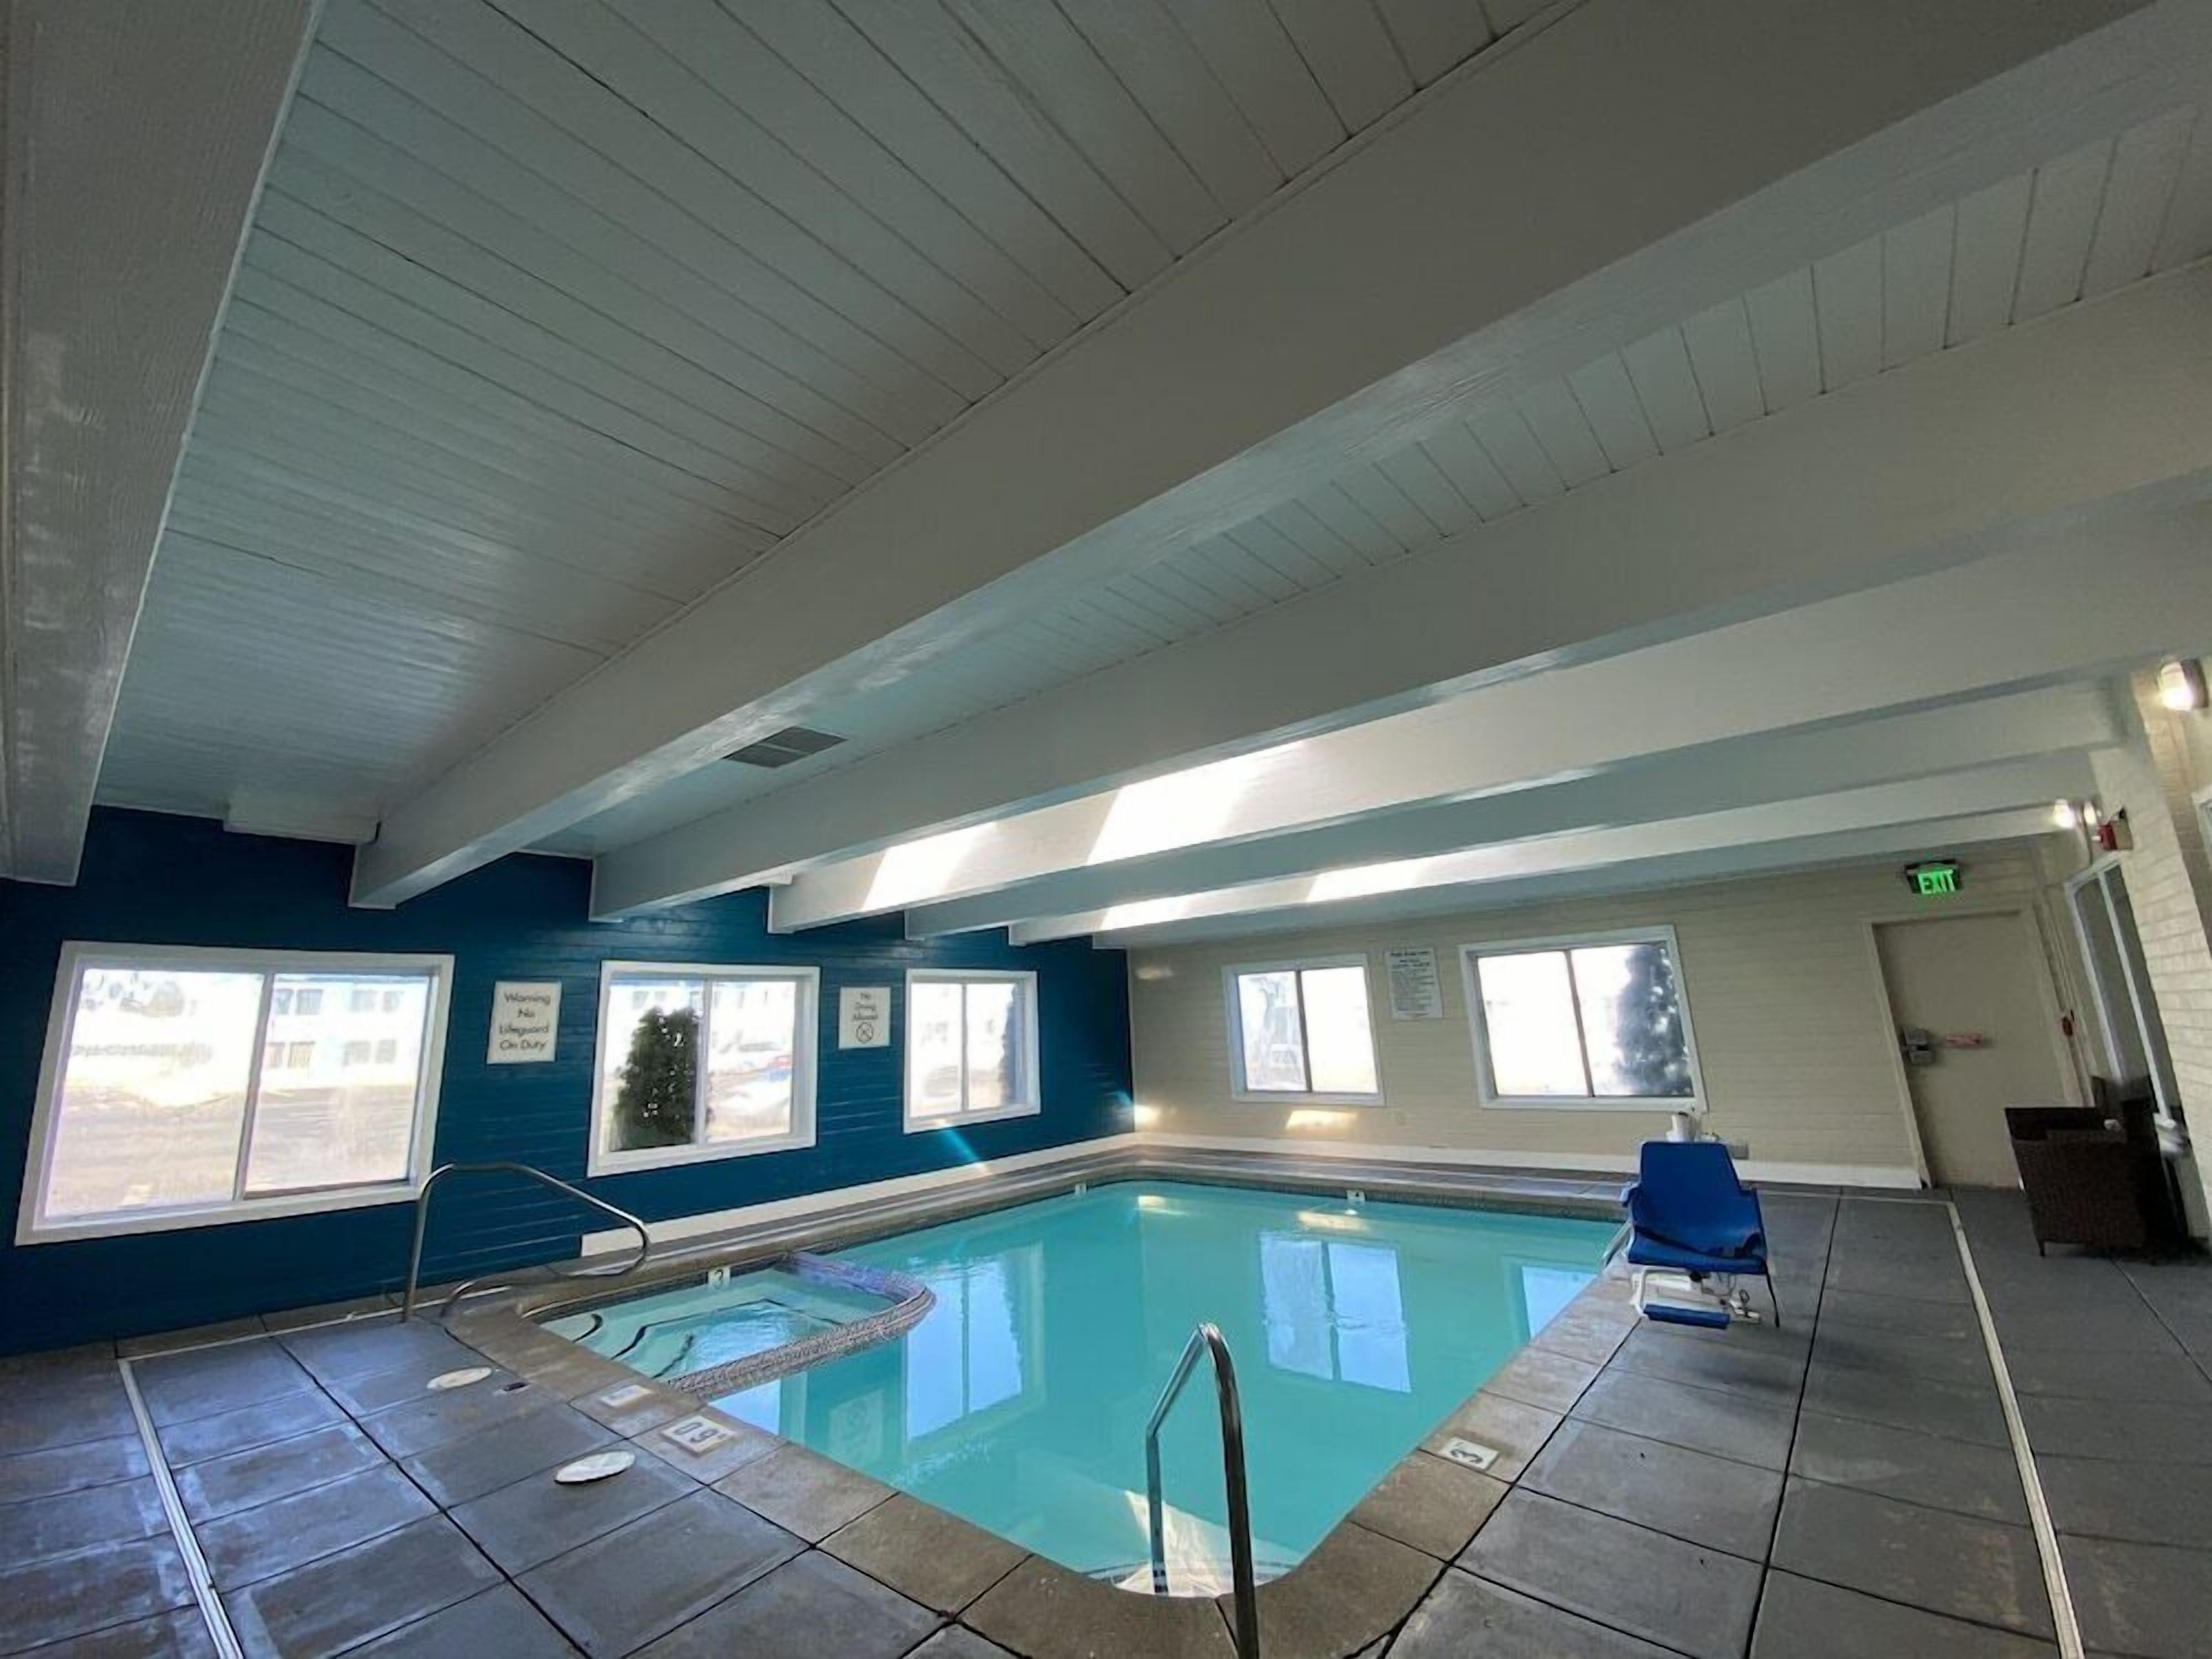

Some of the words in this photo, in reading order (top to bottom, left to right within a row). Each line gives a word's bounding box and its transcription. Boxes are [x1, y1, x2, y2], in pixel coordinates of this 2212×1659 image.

[1918, 869, 1955, 894] EXIT
[504, 992, 551, 1005] Warning
[518, 1009, 535, 1018] No
[499, 1022, 549, 1037] Lifeguard
[500, 1040, 518, 1051] On
[520, 1039, 547, 1052] Duty
